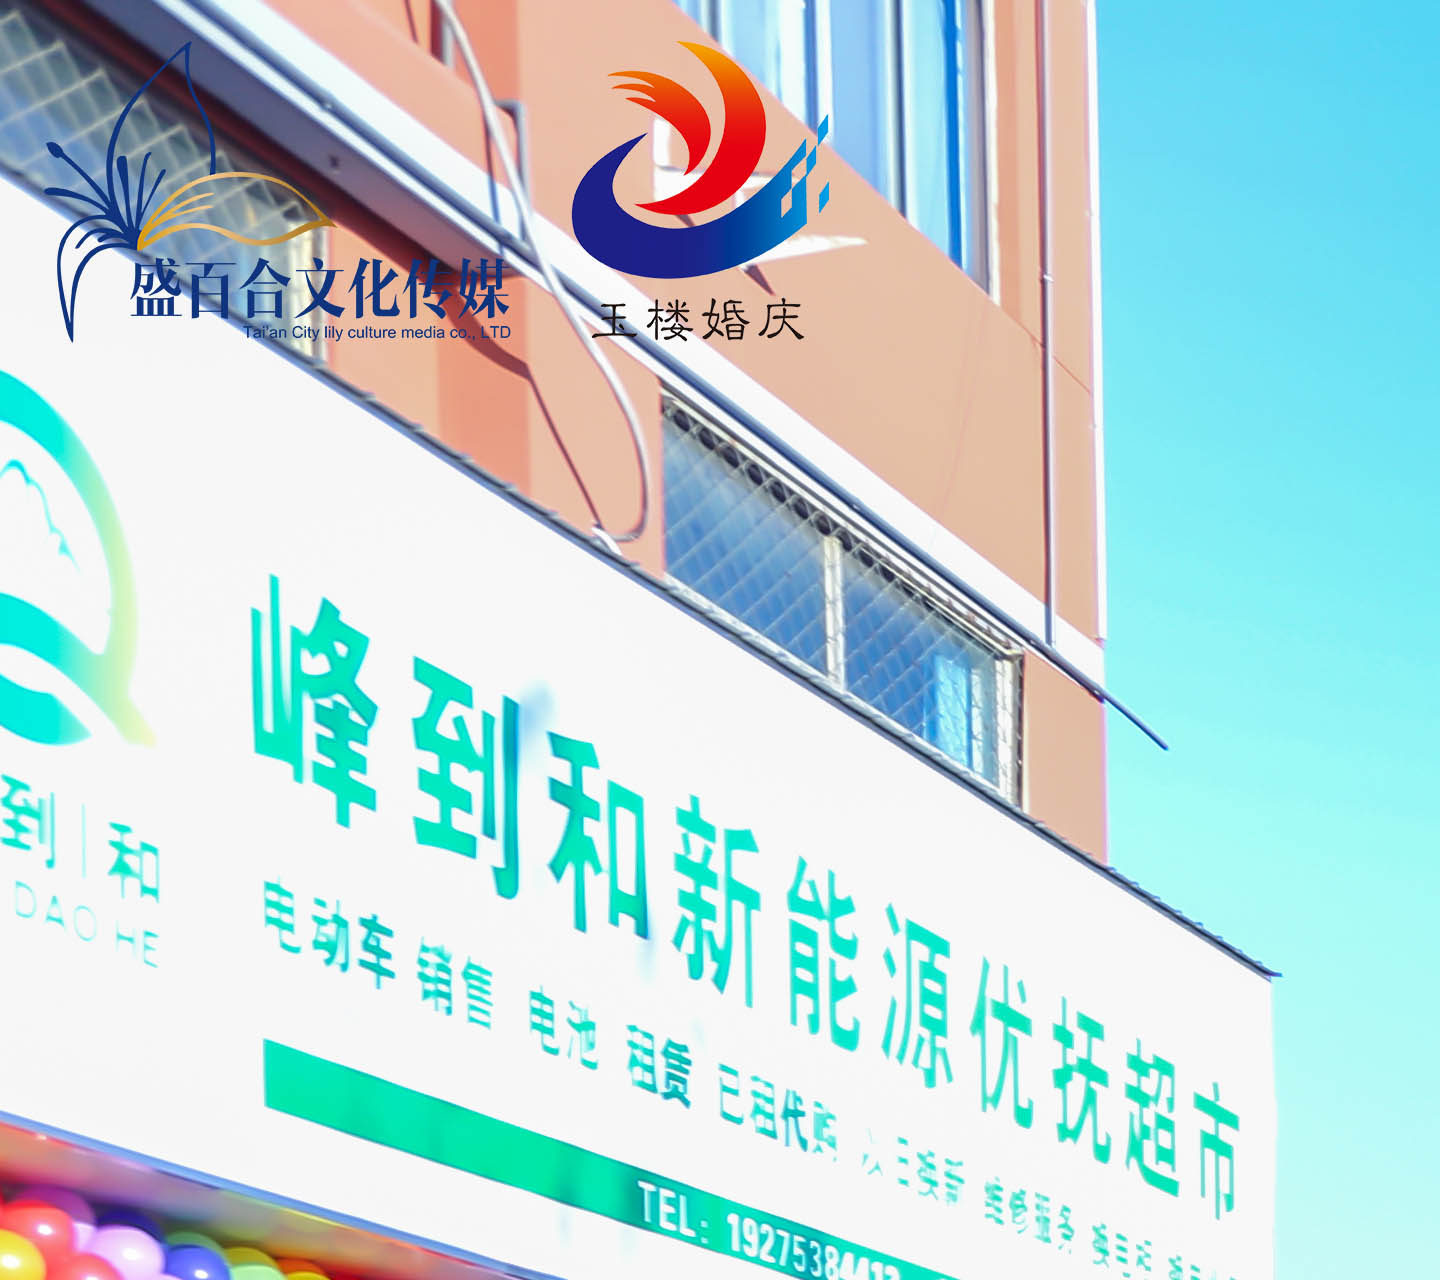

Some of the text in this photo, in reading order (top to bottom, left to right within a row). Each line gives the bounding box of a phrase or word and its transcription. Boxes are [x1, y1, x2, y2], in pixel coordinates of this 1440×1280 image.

[15, 880, 159, 969] DAO HE
[251, 573, 1241, 1221] 峰到和新能源优抚超市
[263, 878, 396, 990] 电动车
[418, 936, 494, 1031] 销售
[528, 985, 599, 1071] 电池
[626, 1024, 692, 1109] 租赁
